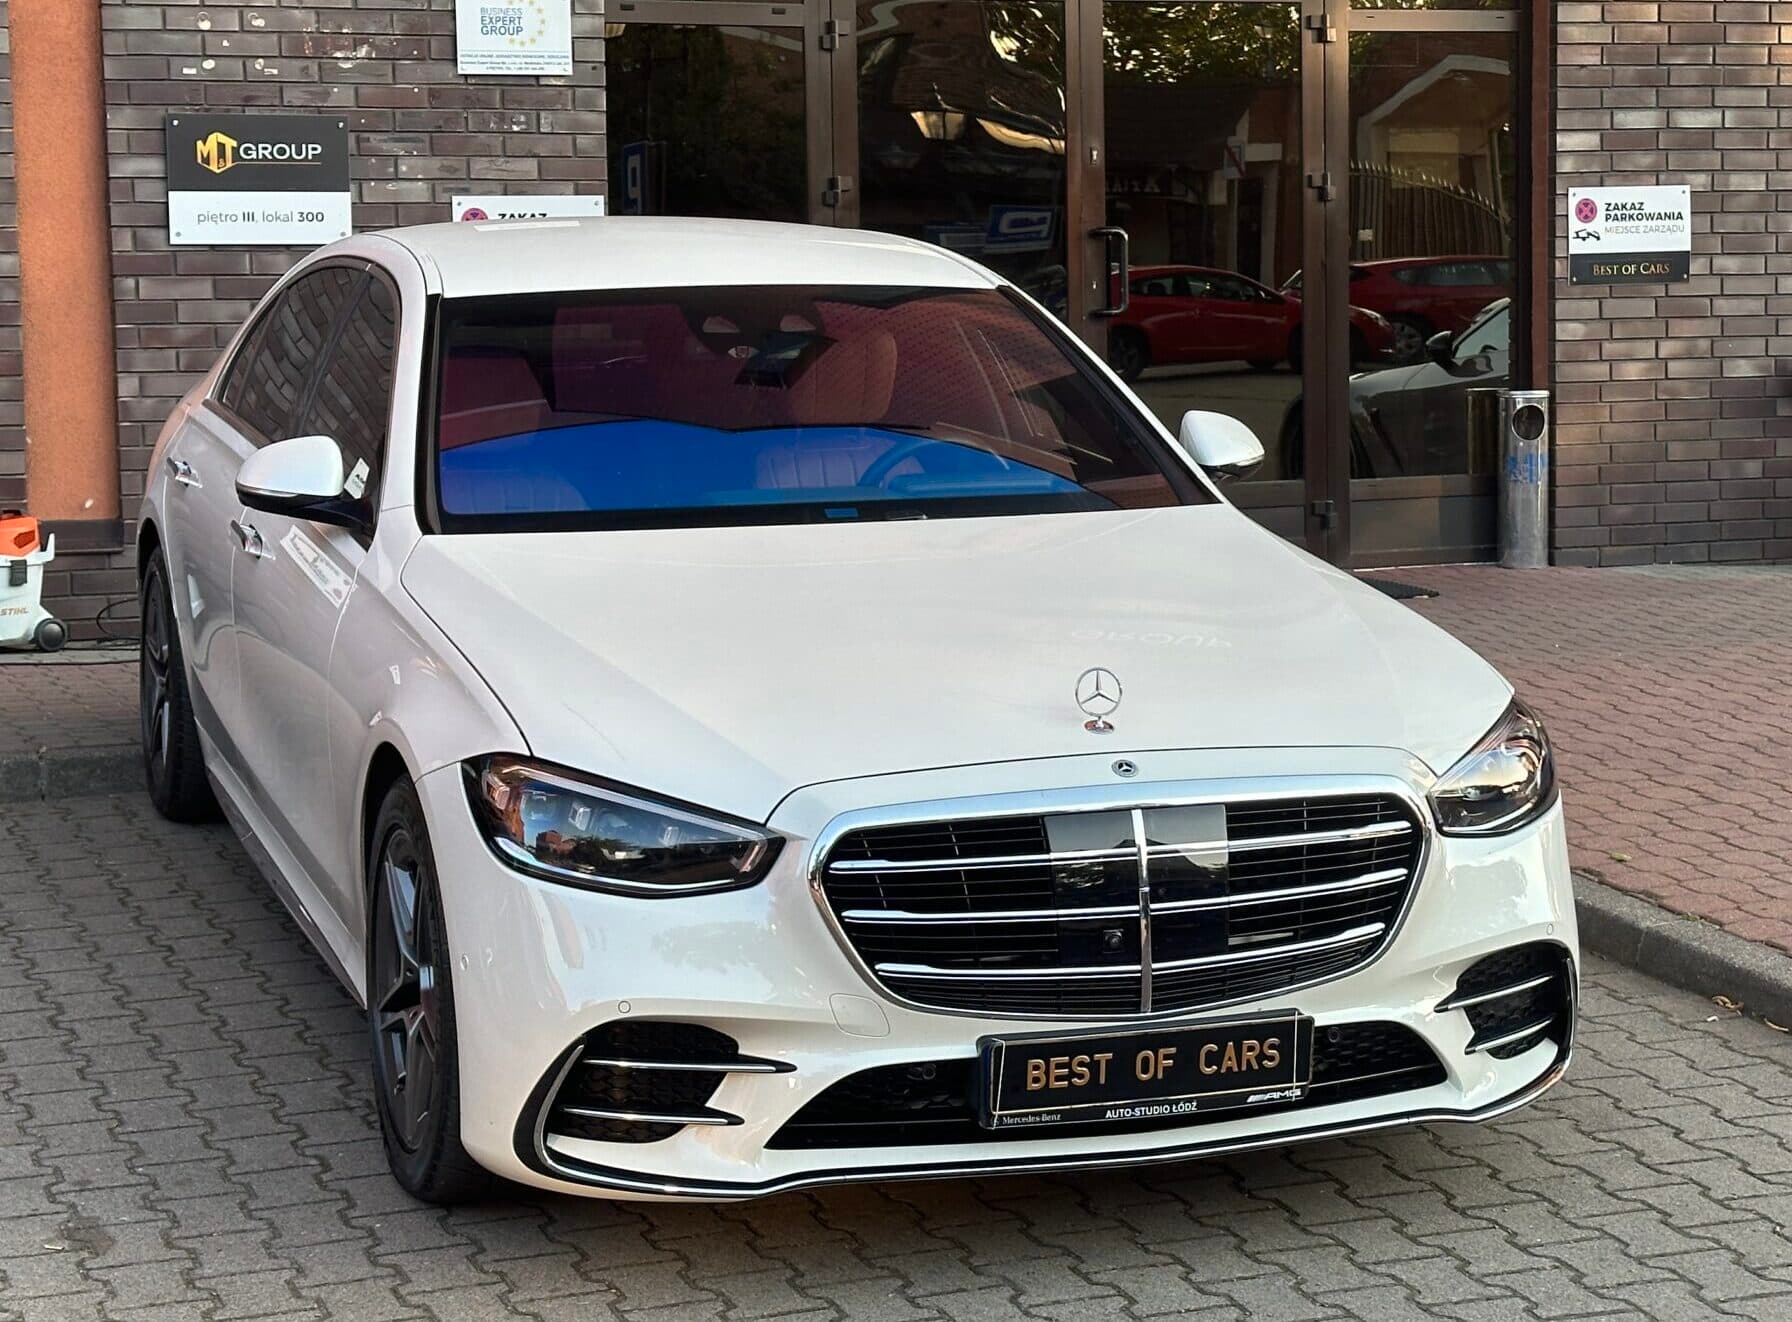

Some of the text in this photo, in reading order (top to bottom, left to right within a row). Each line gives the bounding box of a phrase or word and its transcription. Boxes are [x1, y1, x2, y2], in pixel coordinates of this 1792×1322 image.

[480, 7, 523, 16] BUSINESS
[480, 16, 522, 26] EXPERT
[480, 25, 524, 36] GROUP
[239, 143, 322, 160] GROUP
[1604, 202, 1645, 212] ZAKAZ
[197, 211, 238, 225] piętro
[262, 211, 294, 223] lokal
[297, 211, 325, 223] 300
[1605, 212, 1684, 222] PARKOWANIA
[1604, 224, 1685, 236] MIEJSCE ZARZĄDU
[0, 607, 29, 617] STIHL
[1026, 1038, 1281, 1091] BEST OF CARS
[1105, 1104, 1170, 1119] AUTO-STUDIO
